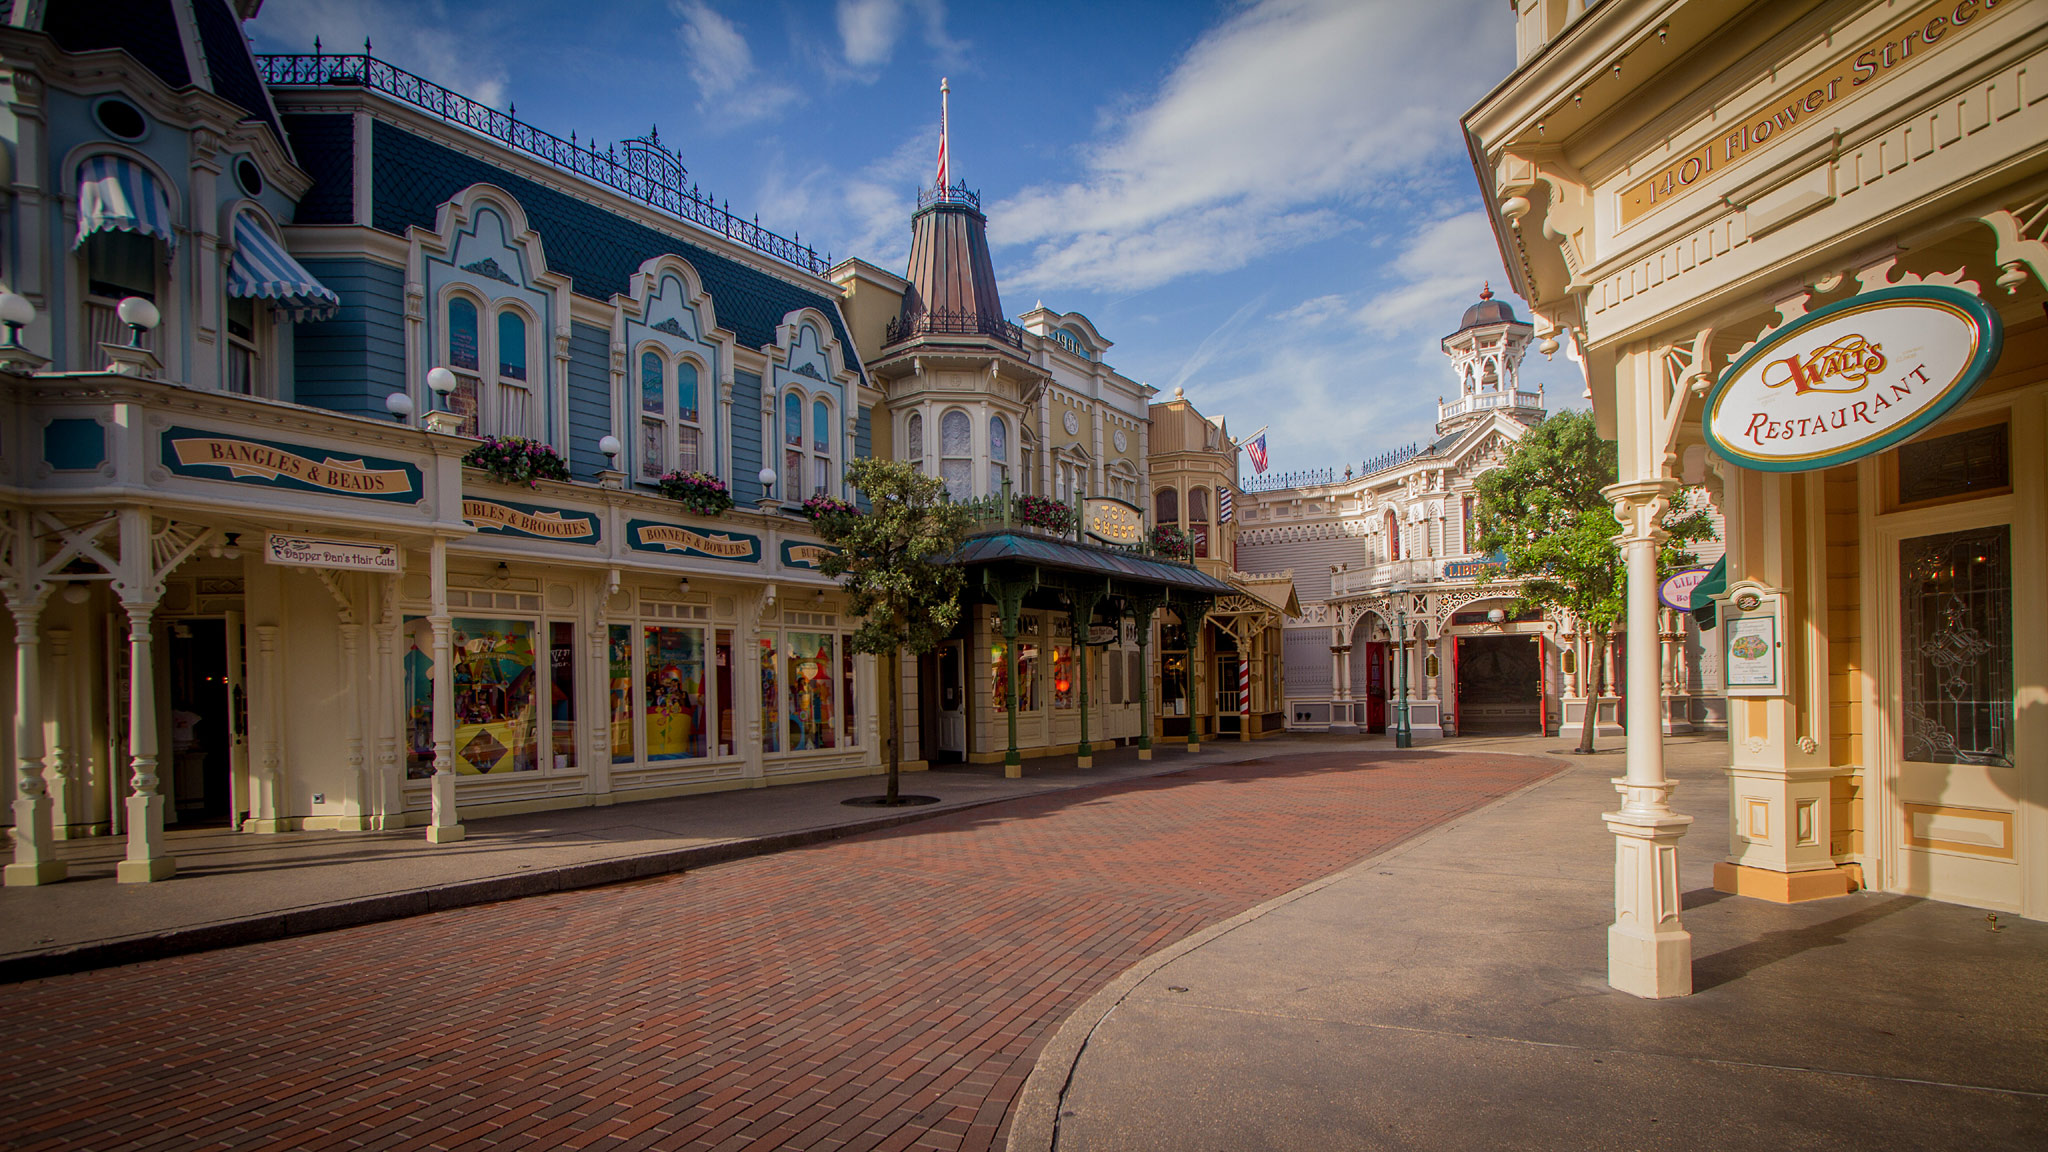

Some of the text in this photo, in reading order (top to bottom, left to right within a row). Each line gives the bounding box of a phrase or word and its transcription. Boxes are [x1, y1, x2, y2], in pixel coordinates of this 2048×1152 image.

[1649, 149, 1714, 206] 1401
[1725, 76, 1843, 161] Flower
[1744, 364, 1931, 446] RESTAURANT
[209, 442, 385, 491] BANGLES & BEADS
[462, 502, 587, 535] UBLES & BROOCHES
[1093, 517, 1135, 539] CHEST
[1101, 505, 1126, 523] TOY
[284, 548, 396, 567] Dapper Dan's Hair Cuts
[646, 529, 747, 556] BONNETS & BOWLERS
